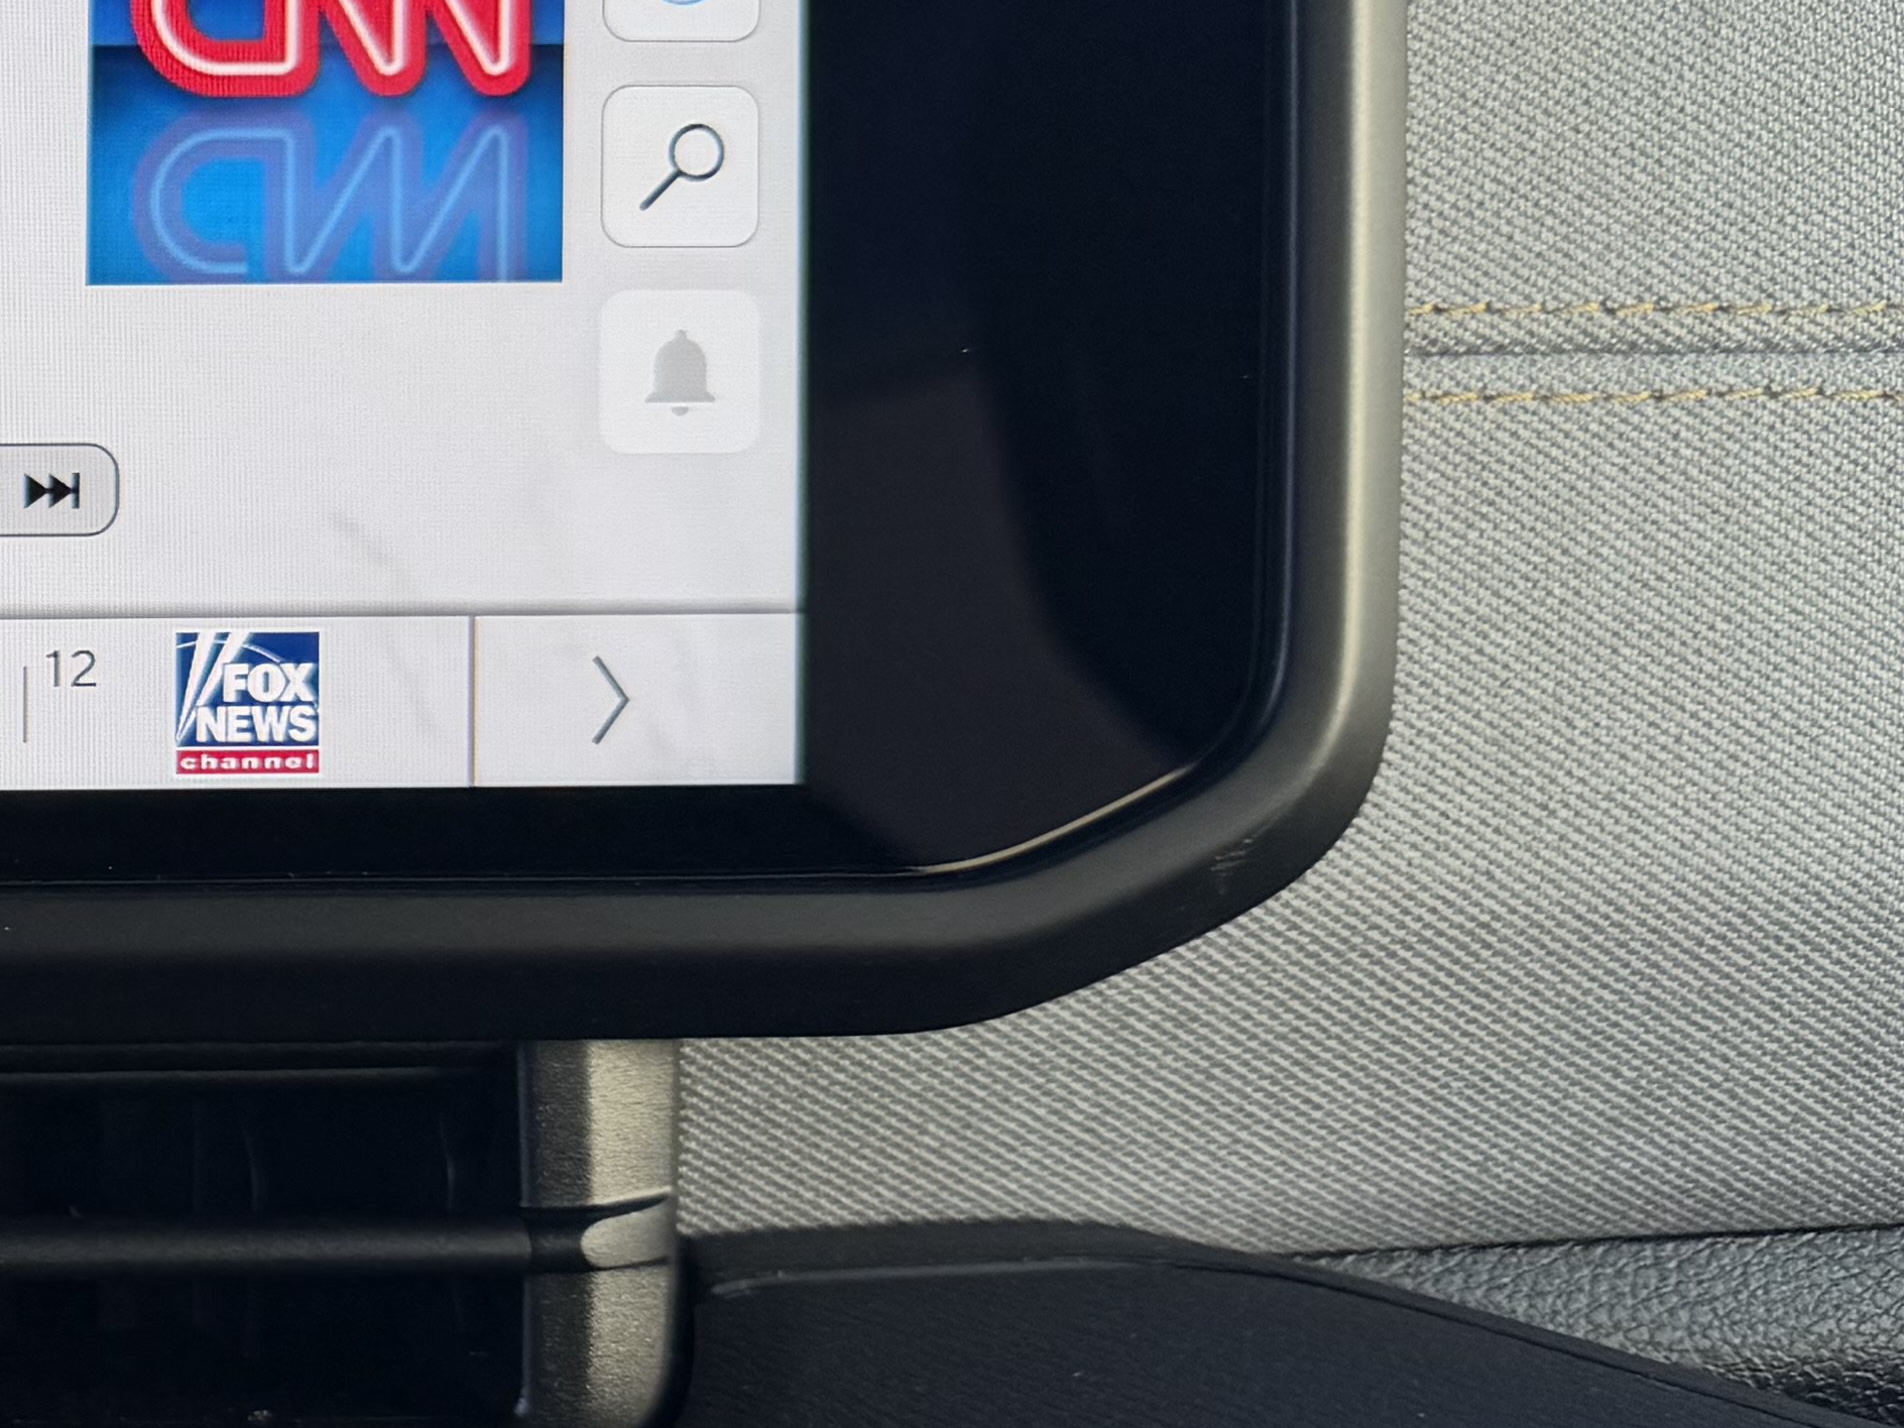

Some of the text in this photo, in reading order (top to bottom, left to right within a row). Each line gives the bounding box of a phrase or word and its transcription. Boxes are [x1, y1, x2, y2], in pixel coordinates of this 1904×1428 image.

[46, 650, 97, 688] 12
[222, 663, 314, 703] FOX
[195, 706, 317, 743] NEWS
[179, 754, 315, 770] channel
